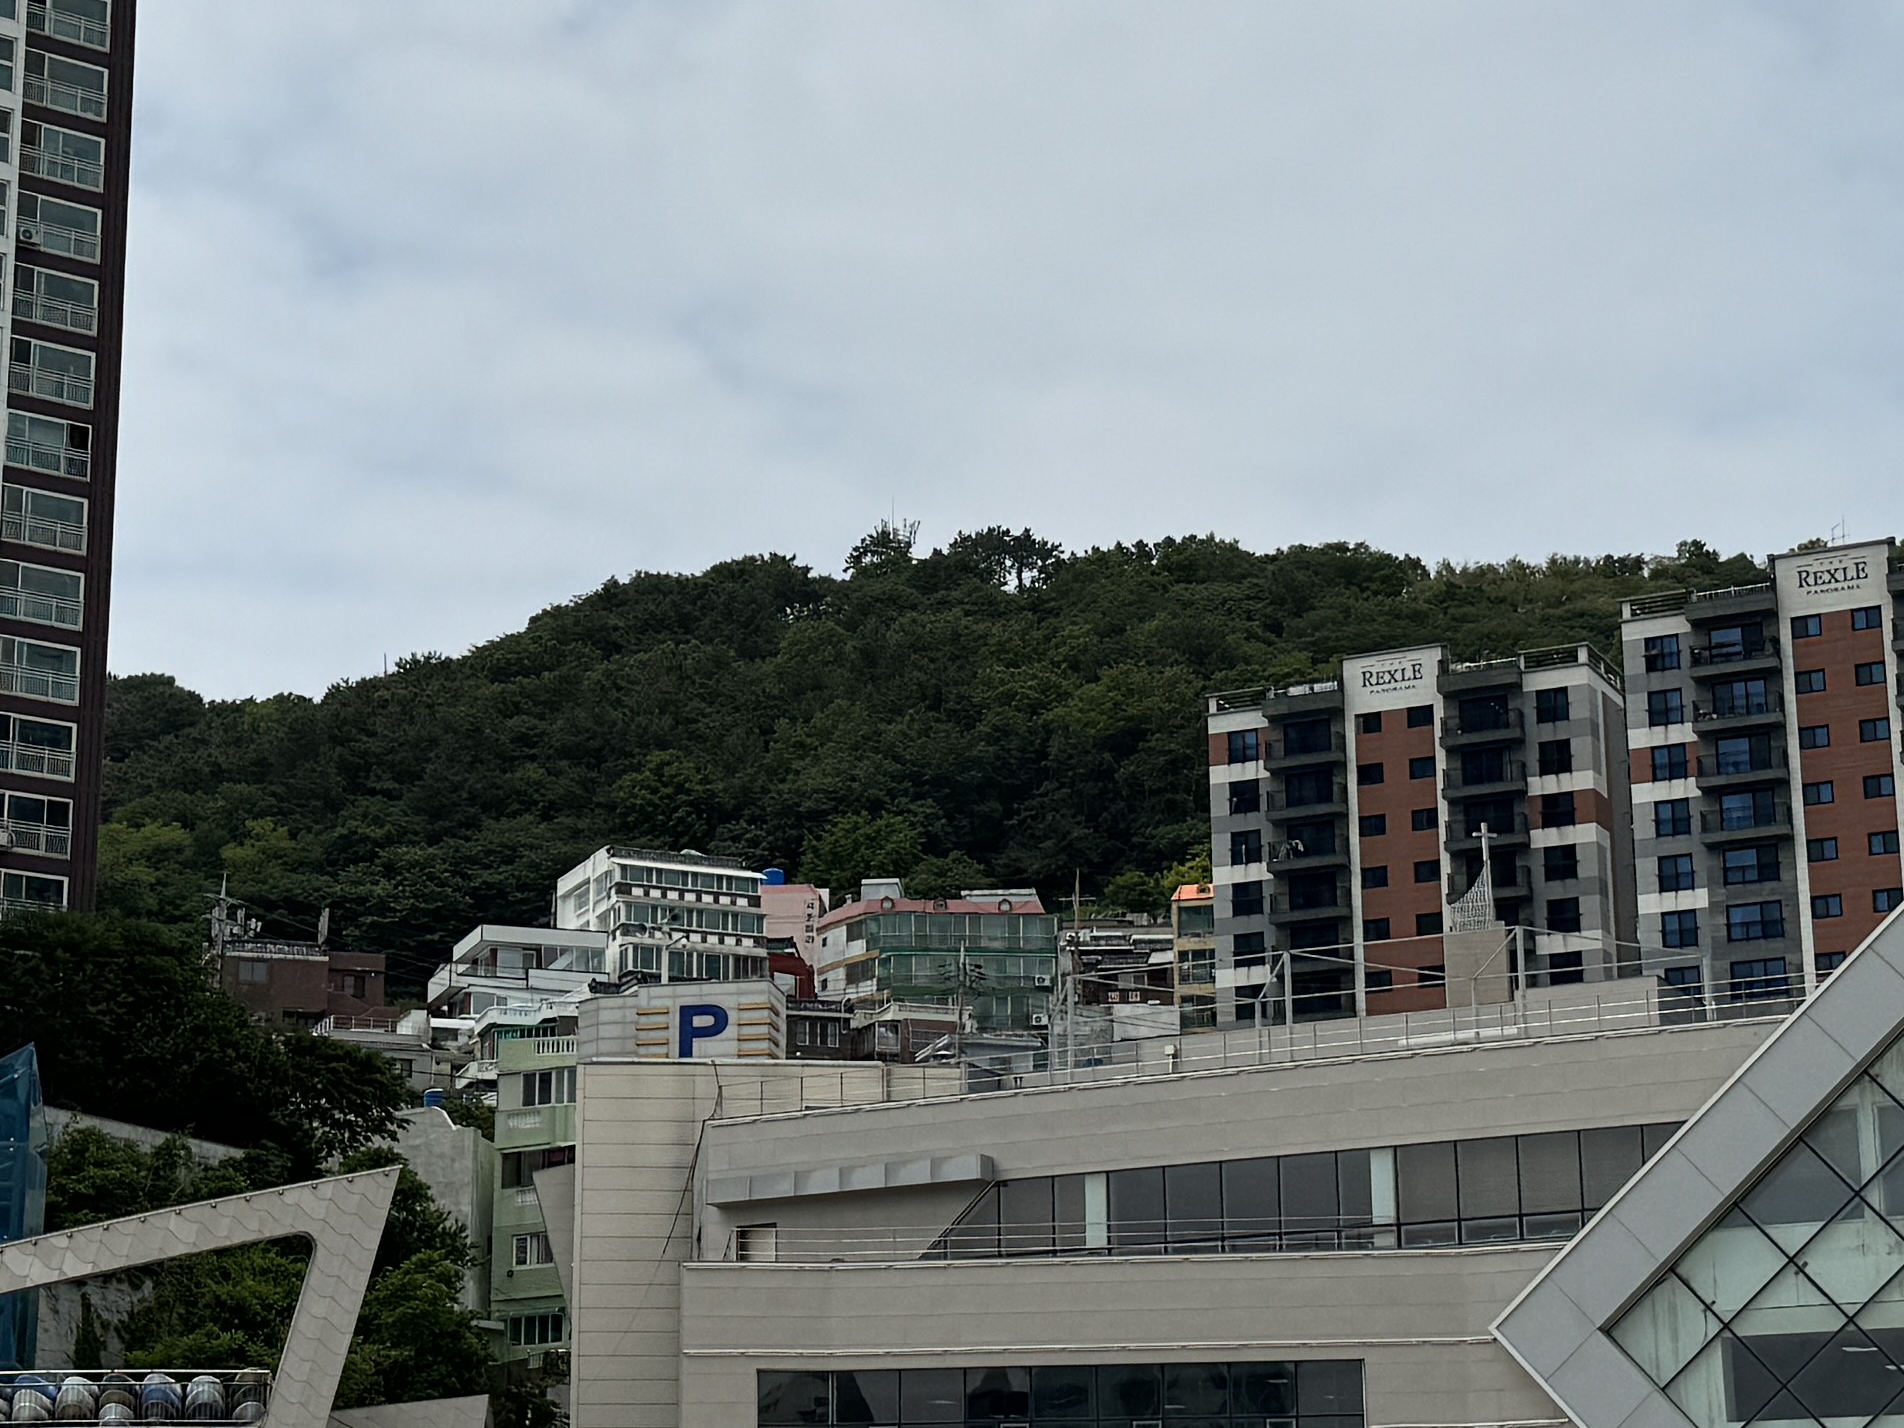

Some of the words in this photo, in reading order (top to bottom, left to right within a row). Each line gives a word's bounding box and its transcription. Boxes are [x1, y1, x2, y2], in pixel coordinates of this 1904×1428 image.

[1796, 561, 1868, 588] REXLE
[1361, 663, 1423, 688] REXLE
[679, 1004, 729, 1058] P
